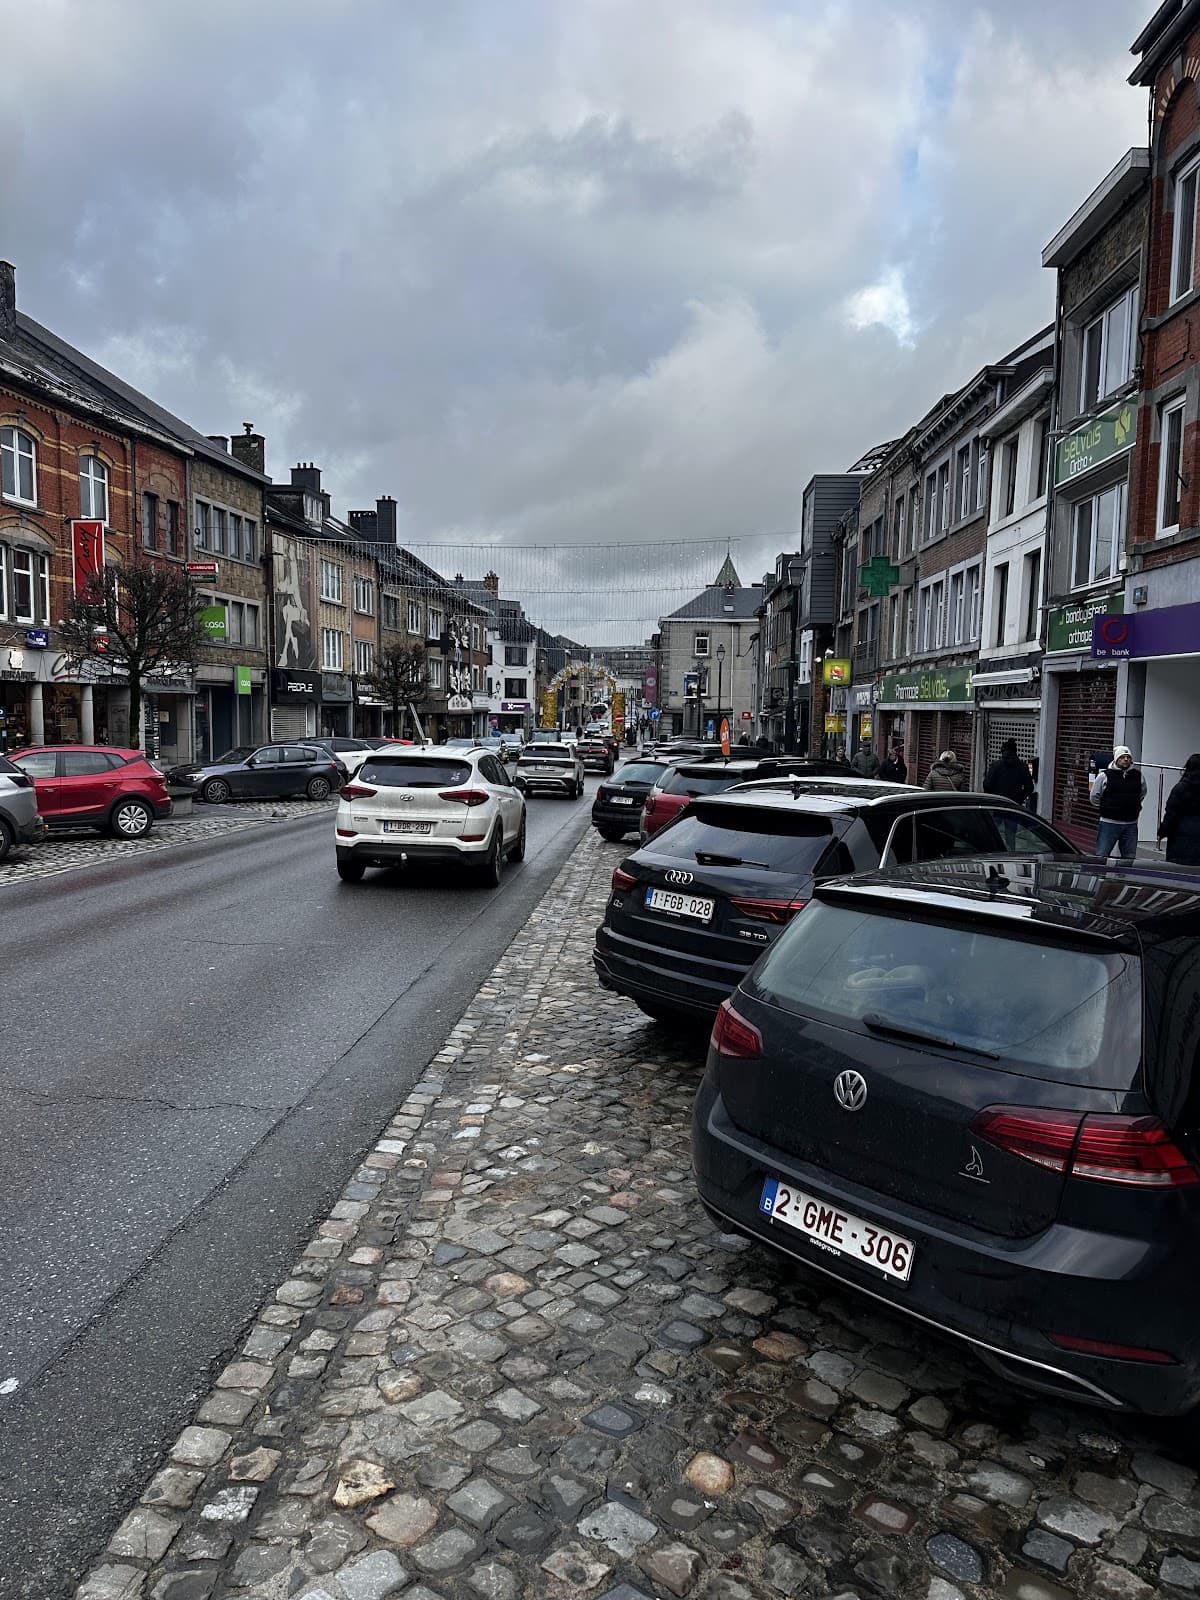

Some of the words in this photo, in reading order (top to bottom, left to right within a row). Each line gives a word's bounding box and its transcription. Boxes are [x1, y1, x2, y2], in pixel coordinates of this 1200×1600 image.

[1069, 456, 1088, 475] Ortho
[1096, 648, 1130, 656] bebank
[287, 682, 314, 693] PEOPLE
[764, 1199, 773, 1211] B
[775, 1189, 909, 1272] 2-GME-306
